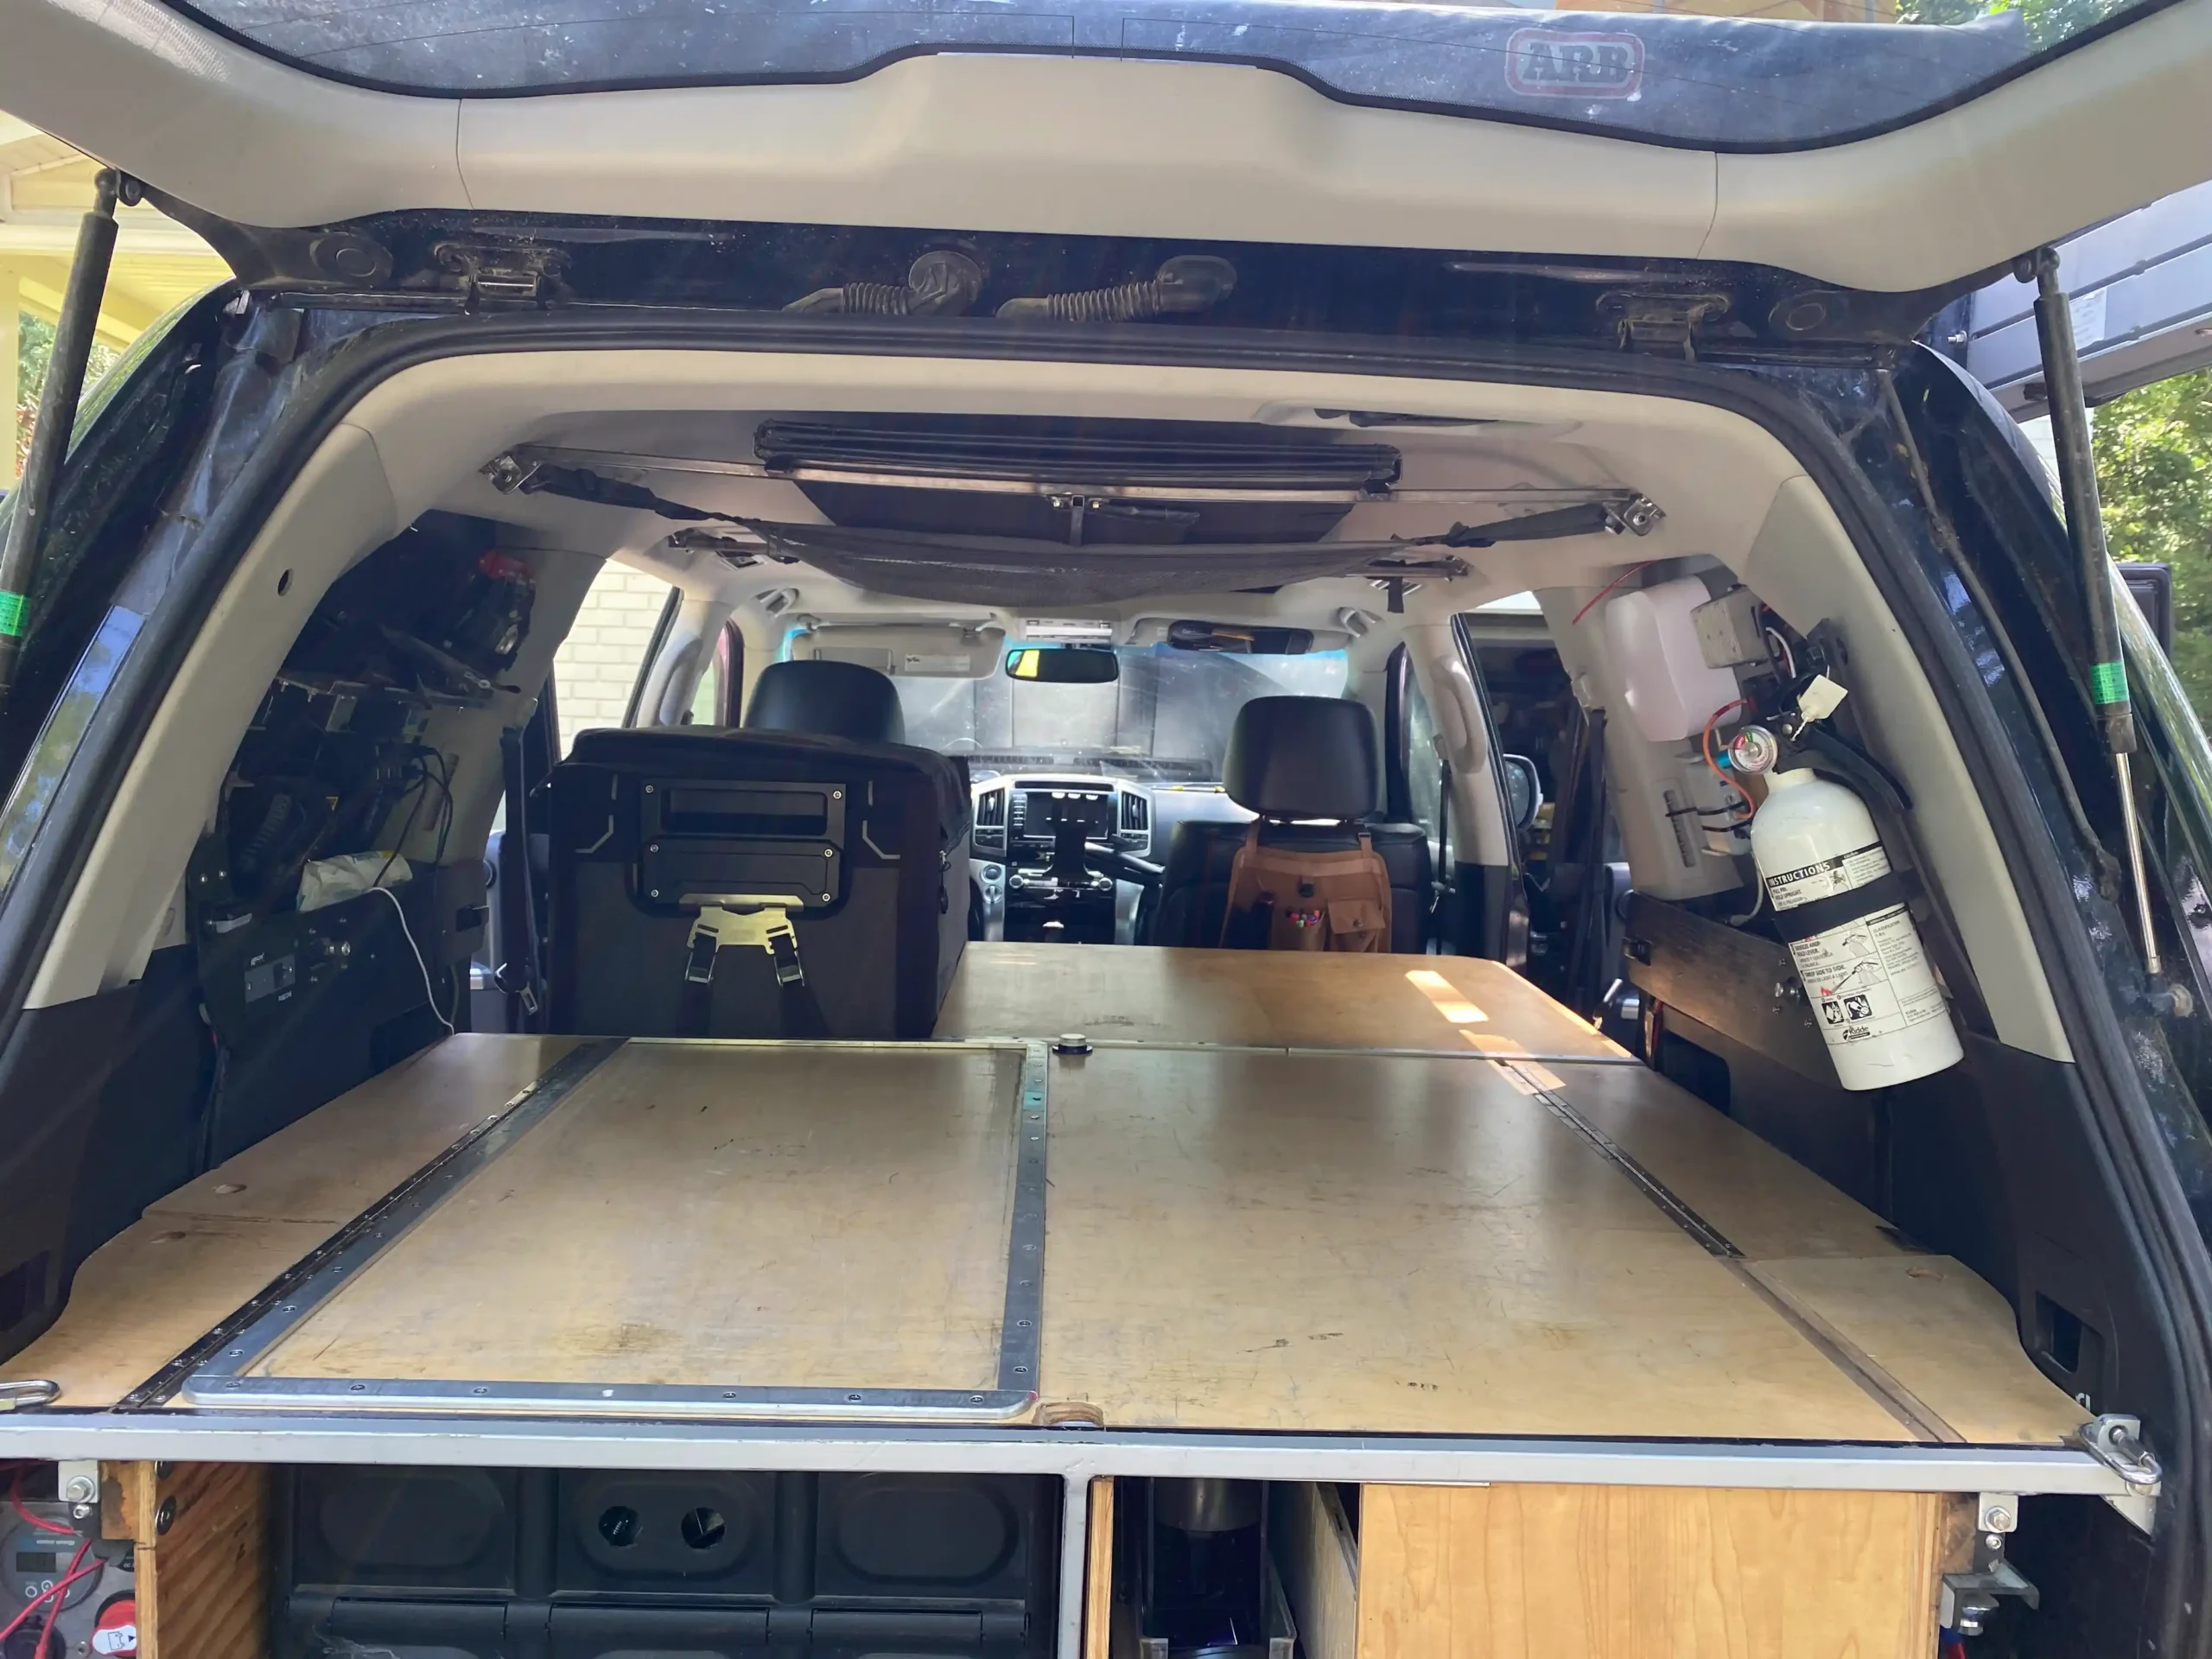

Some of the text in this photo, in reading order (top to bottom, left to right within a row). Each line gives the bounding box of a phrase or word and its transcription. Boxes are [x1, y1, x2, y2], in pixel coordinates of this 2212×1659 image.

[1522, 42, 1630, 83] ARB
[1768, 861, 1830, 887] INSTRUCTIONS
[1849, 1026, 1869, 1034] Kidde
